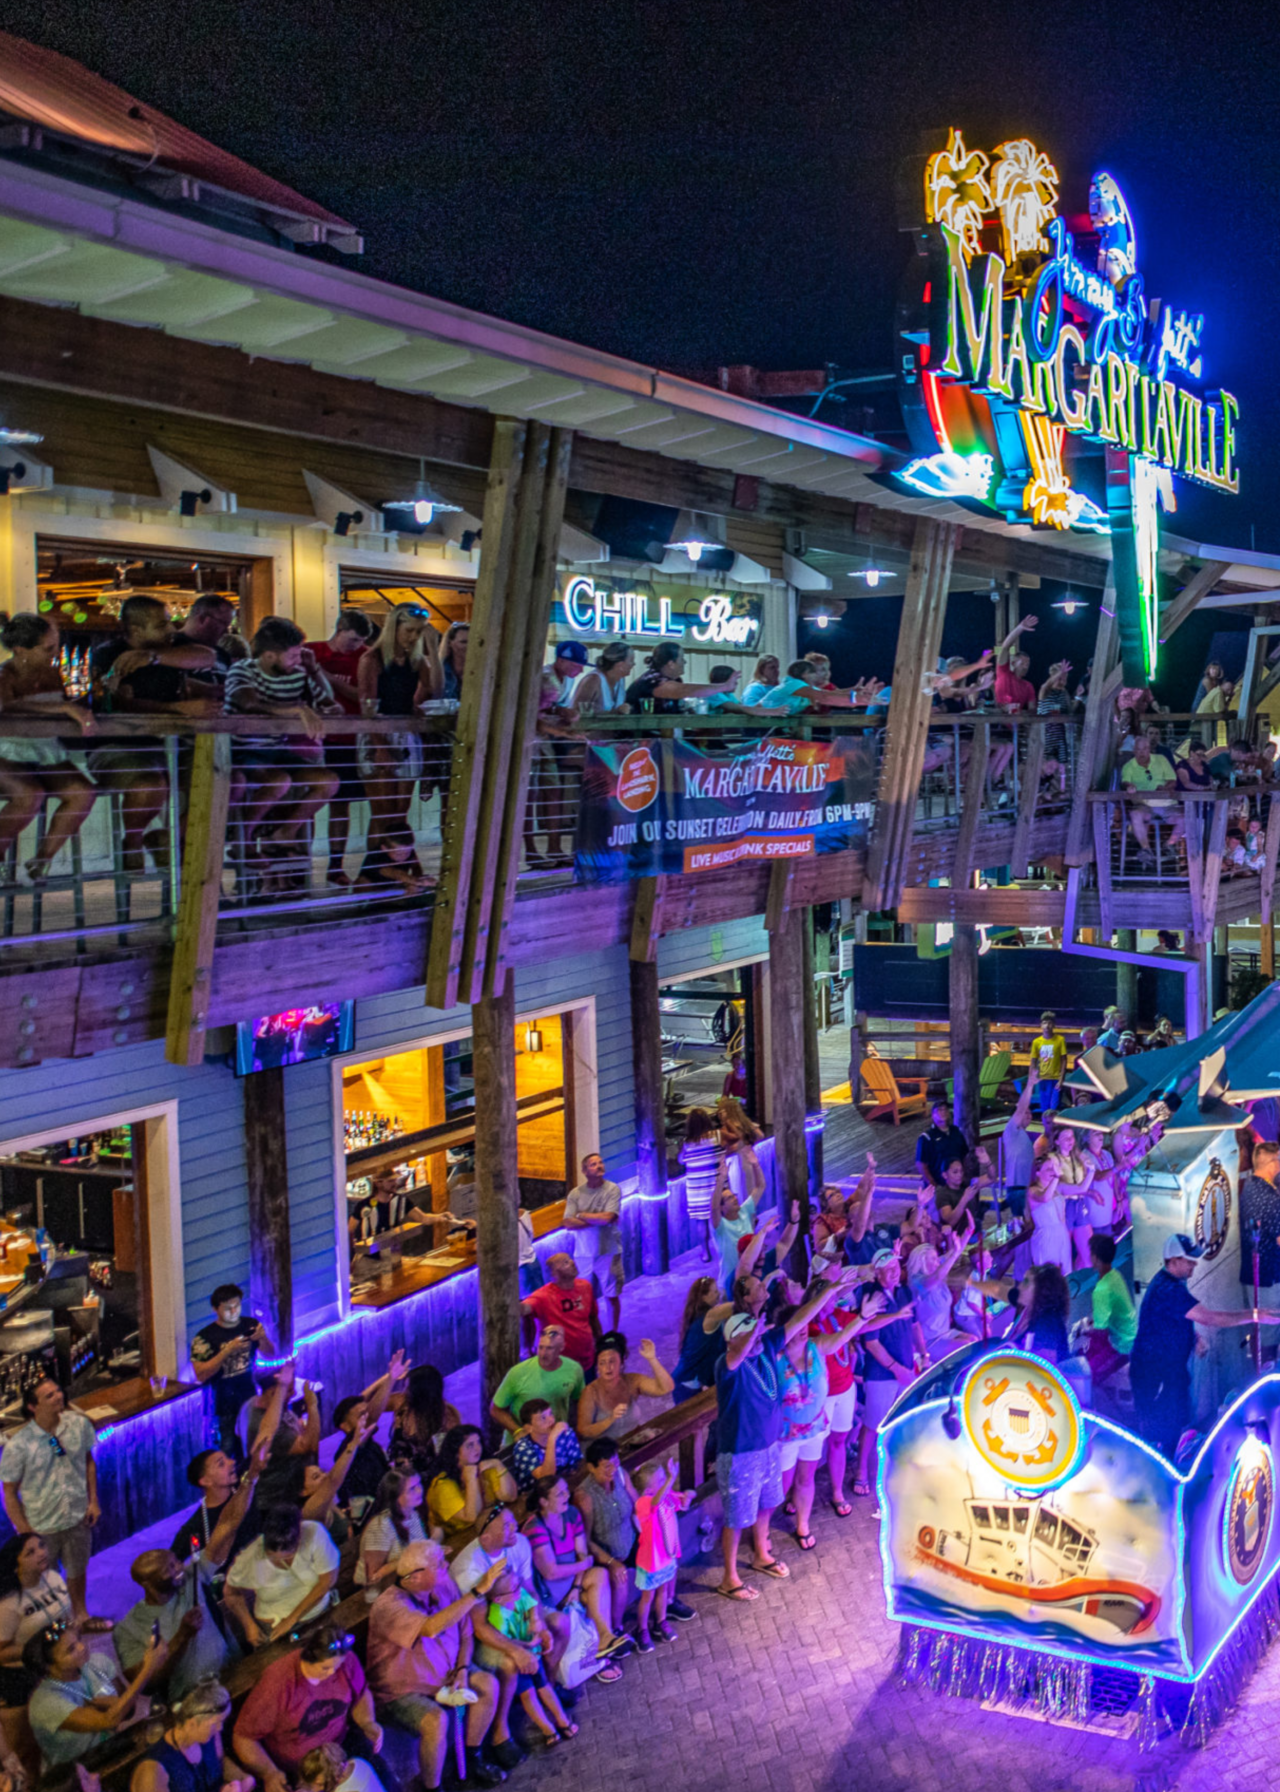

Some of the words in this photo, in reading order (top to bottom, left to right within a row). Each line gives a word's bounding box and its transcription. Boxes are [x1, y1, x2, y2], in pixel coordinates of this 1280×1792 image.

[942, 222, 1240, 495] MARGARITAVILLE
[563, 575, 686, 639] CHILL
[691, 594, 760, 643] Bar
[607, 823, 638, 847] JOIN
[665, 819, 714, 841] SUNSET
[768, 810, 803, 830] DAILY
[691, 853, 712, 868] LIVE
[765, 840, 811, 855] SPECIALS
